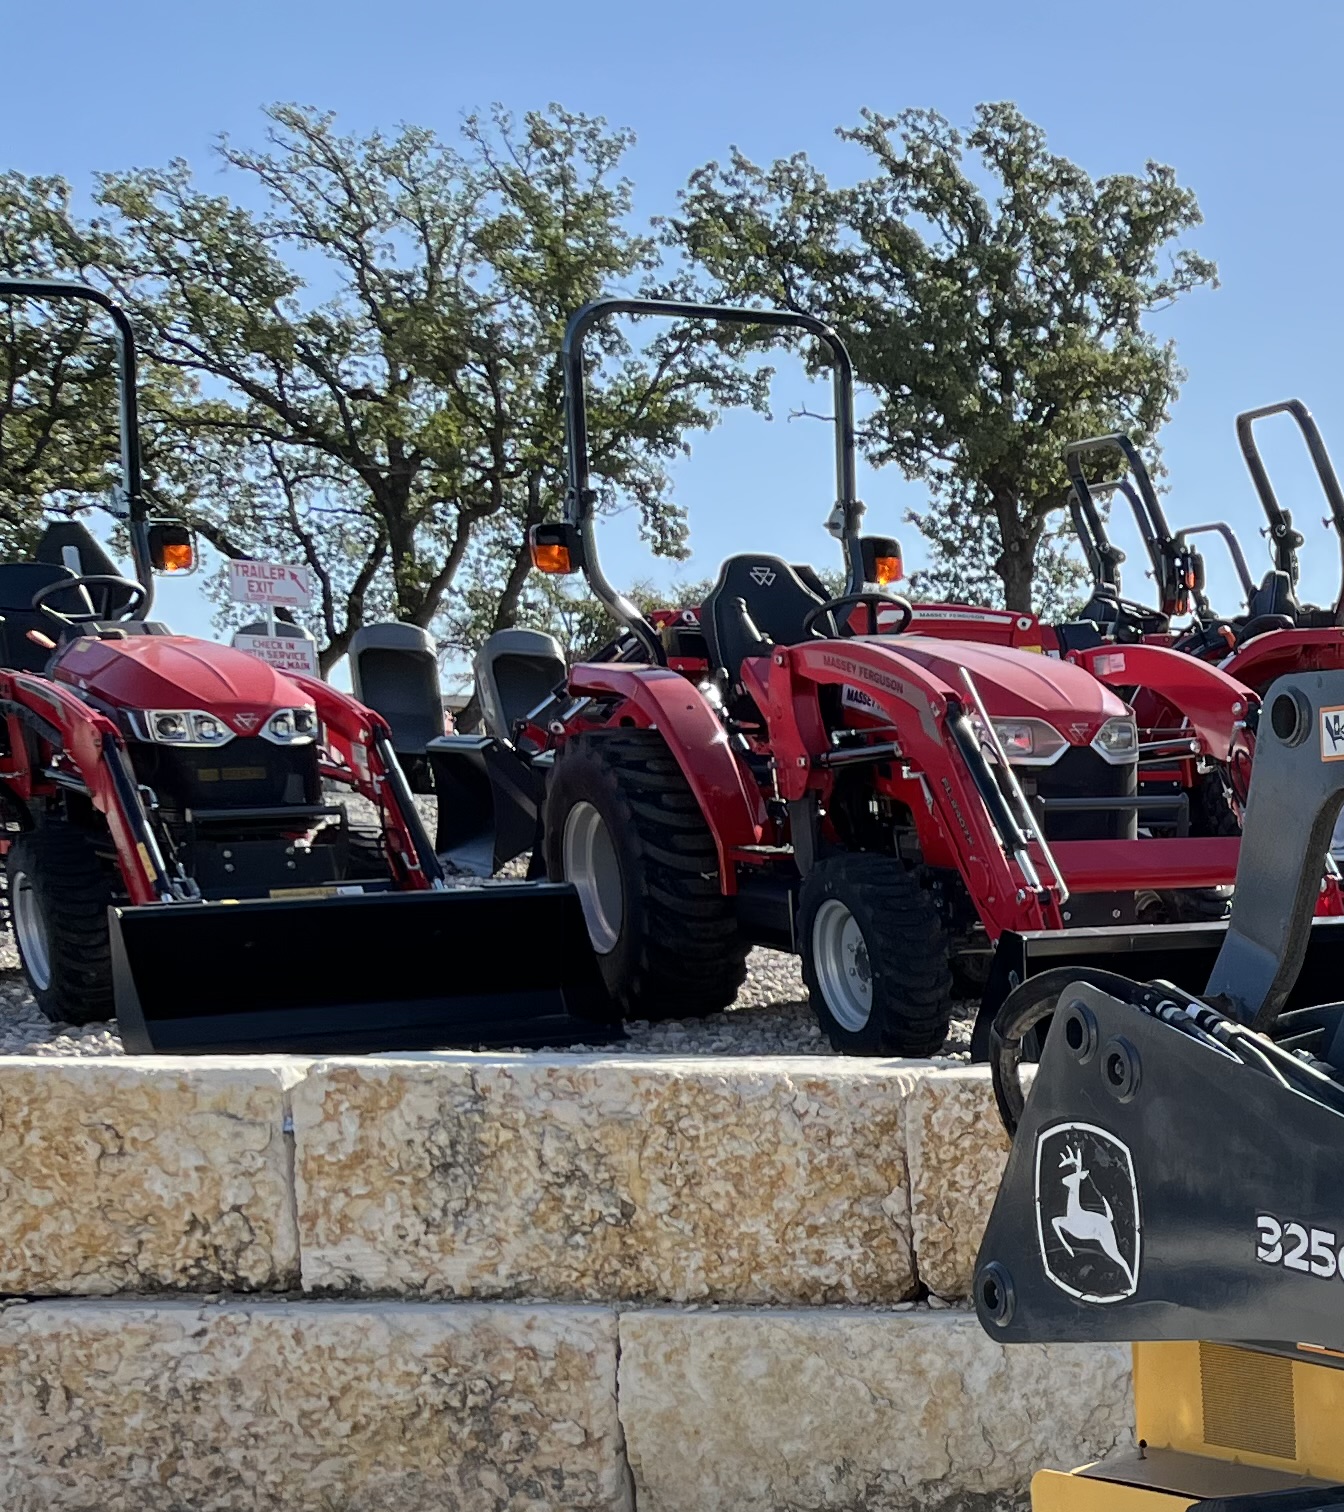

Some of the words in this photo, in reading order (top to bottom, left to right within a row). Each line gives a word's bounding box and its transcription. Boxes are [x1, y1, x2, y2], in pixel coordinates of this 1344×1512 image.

[232, 563, 286, 580] TRAILER
[247, 580, 275, 593] EXIT
[252, 640, 283, 650] CHECK
[285, 642, 295, 650] IN
[266, 650, 307, 660] SERVICE
[286, 661, 311, 671] MAIN
[823, 655, 857, 675] MASSEY
[858, 664, 904, 694] FERGUSON
